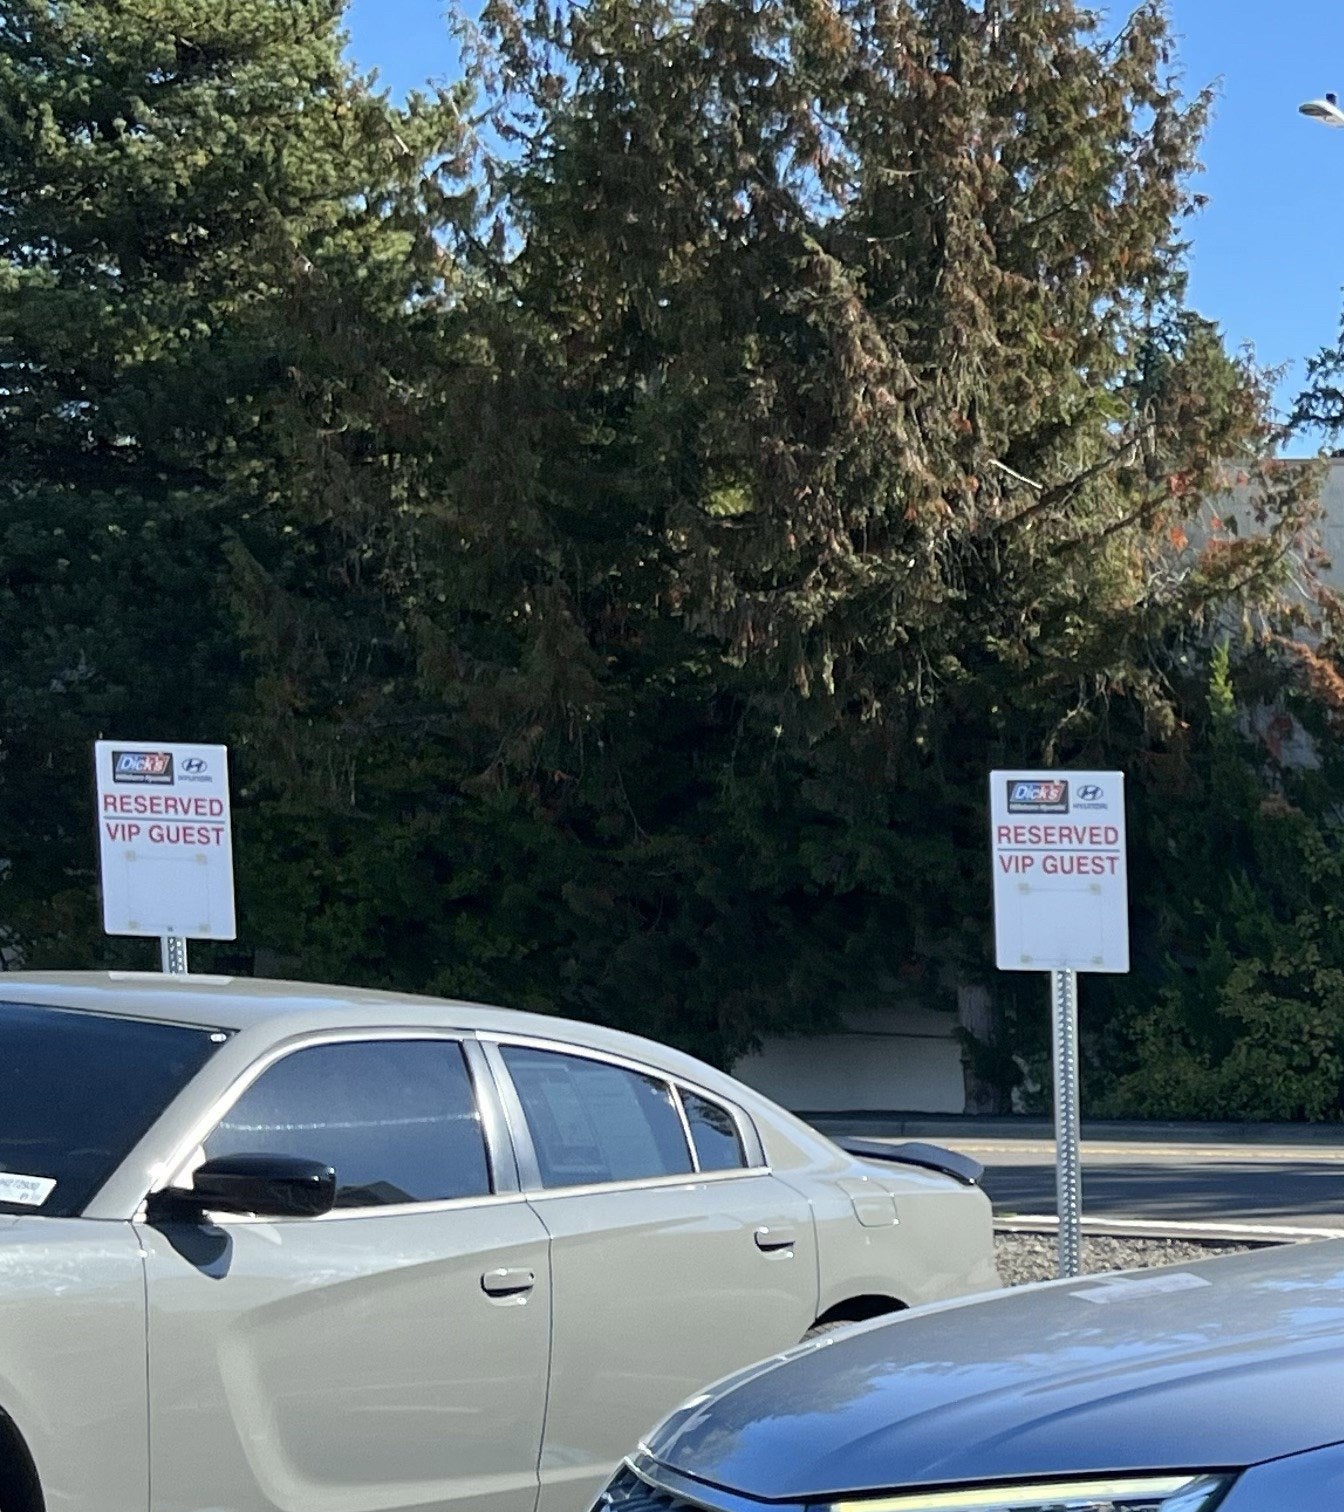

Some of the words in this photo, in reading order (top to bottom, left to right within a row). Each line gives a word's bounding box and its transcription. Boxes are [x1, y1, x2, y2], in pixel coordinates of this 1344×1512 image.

[103, 794, 224, 817] RESERVED
[106, 822, 141, 842] VIP
[149, 824, 225, 845] GUEST
[997, 825, 1119, 845] RESERVED
[999, 855, 1034, 874] VIP
[1042, 855, 1120, 875] GUEST
